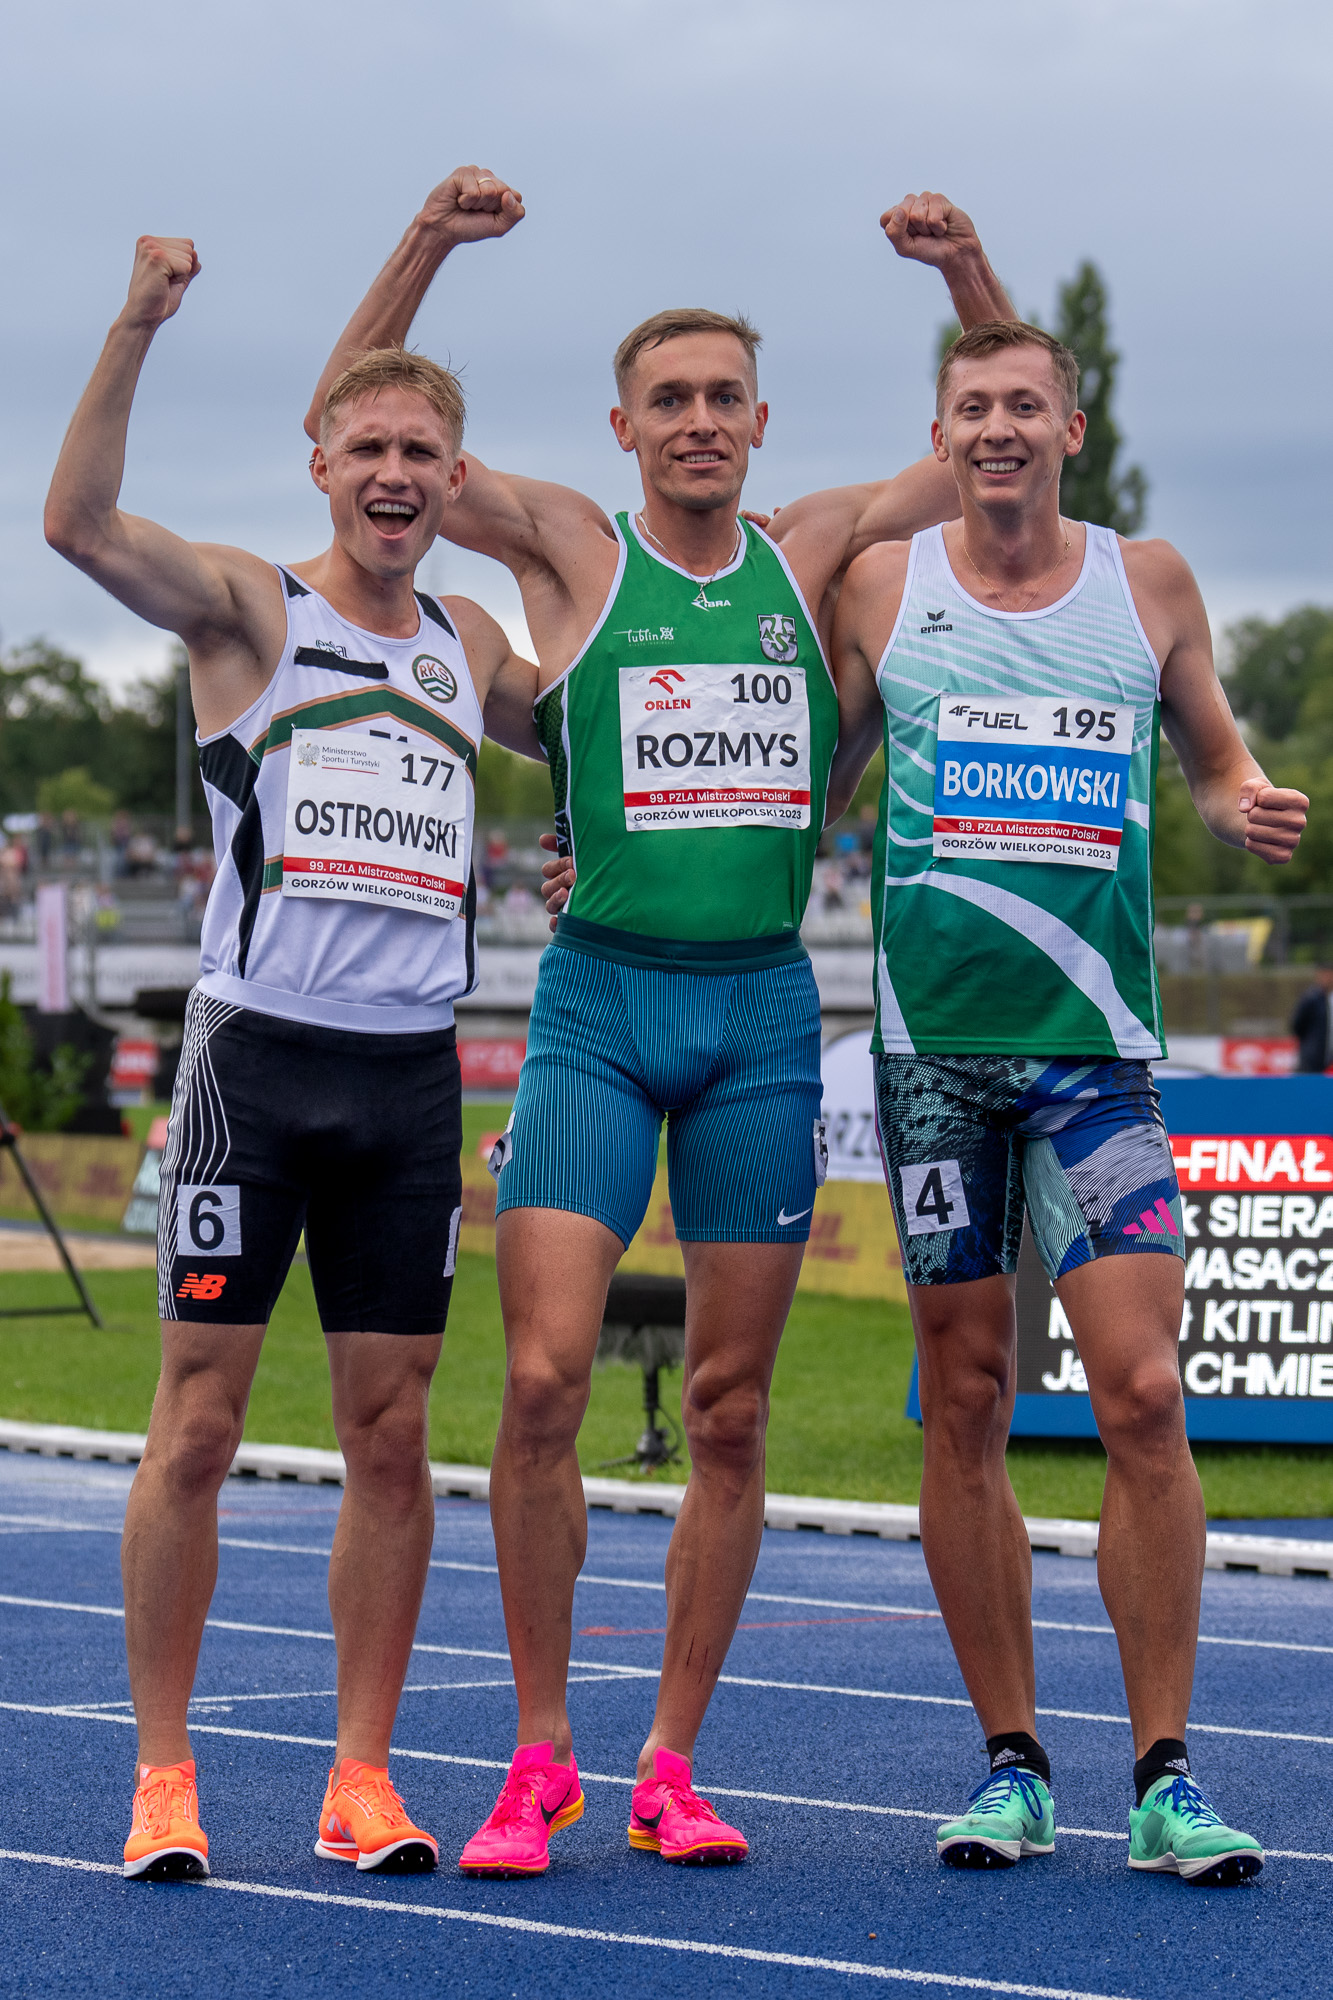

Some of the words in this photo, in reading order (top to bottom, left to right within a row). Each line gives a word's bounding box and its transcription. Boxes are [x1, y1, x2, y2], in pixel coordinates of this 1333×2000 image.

[920, 623, 953, 634] erima
[418, 662, 449, 682] RKS
[730, 673, 792, 705] 100
[644, 698, 691, 711] ORLEN
[948, 705, 971, 716] 4F
[967, 711, 1029, 730] FUEL
[1052, 706, 1117, 742] 195
[321, 746, 368, 758] Ministerstwo
[321, 755, 346, 764] Sportu
[350, 758, 381, 769] Turystyki
[636, 731, 799, 770] ROZMYS
[400, 753, 455, 792] 177
[943, 760, 1121, 809] BORKOWSKI
[649, 793, 667, 804] 99.
[669, 792, 695, 803] PZLA
[696, 790, 760, 802] Mistrzostwa
[762, 791, 791, 802] Polski
[295, 799, 457, 859] OSTROWSKI
[634, 808, 690, 822] GORZÓW
[693, 808, 778, 819] WIELKOPOLSKI
[779, 809, 802, 820] 2023
[958, 821, 975, 832] 99.
[977, 823, 1003, 833] PZLA
[1005, 824, 1070, 837] Mistrzostwa
[1071, 828, 1100, 841] Polski
[1000, 841, 1086, 856] WIELKOPOLSKI
[1086, 848, 1112, 860] 2023
[309, 860, 327, 872] 99.
[329, 862, 356, 874] PZLA
[357, 865, 419, 884] Mistrzostwa
[420, 876, 446, 891] Polski
[291, 878, 349, 891] GORZÓW
[352, 883, 432, 905] WIELKOPOLSKI
[433, 897, 456, 911] 2023
[1169, 1140, 1333, 1182] -FINAŁ
[915, 1167, 954, 1226] 4
[189, 1190, 225, 1251] 6
[175, 1272, 227, 1300] NB
